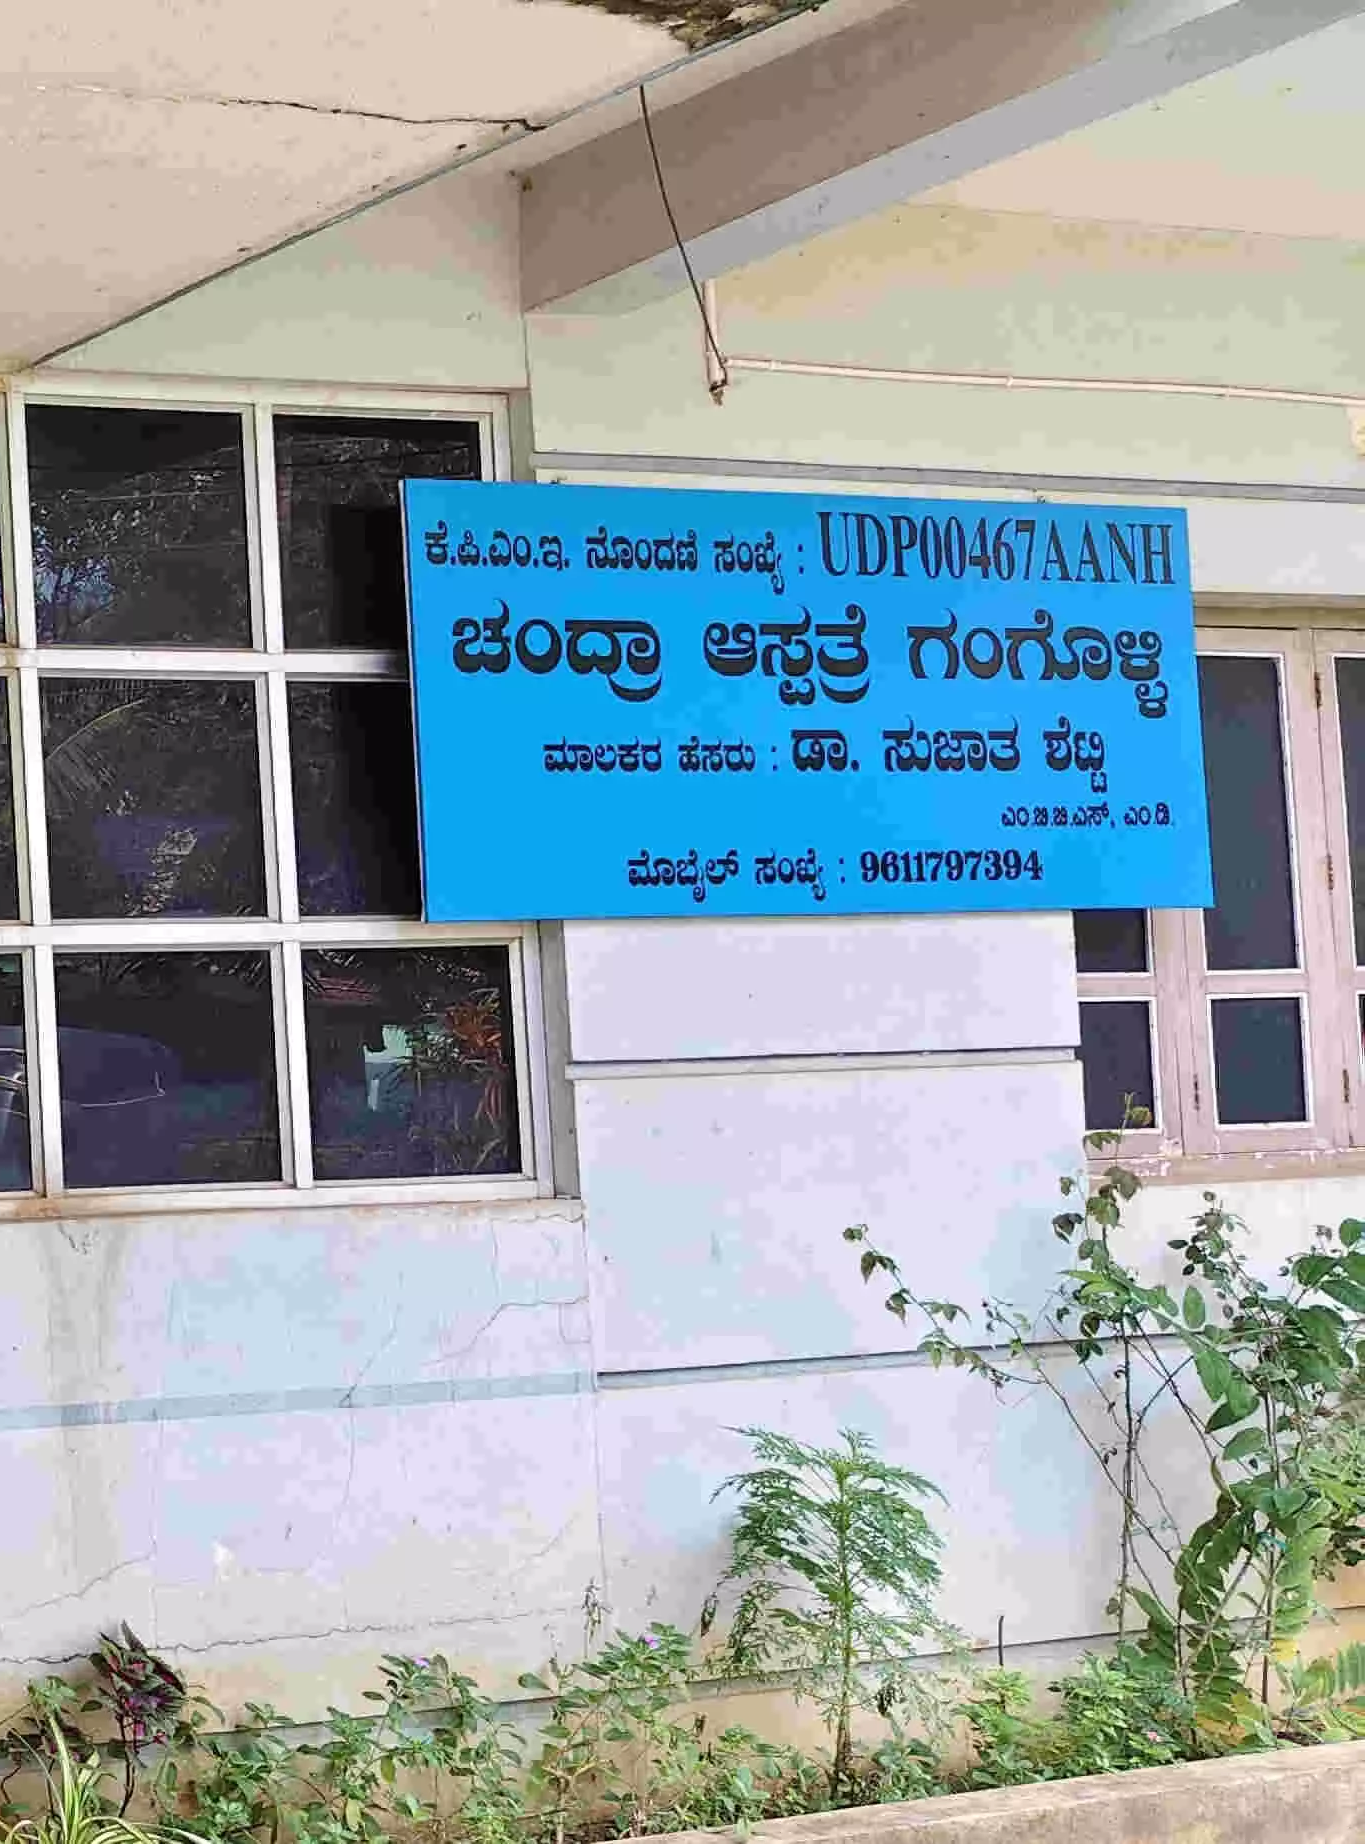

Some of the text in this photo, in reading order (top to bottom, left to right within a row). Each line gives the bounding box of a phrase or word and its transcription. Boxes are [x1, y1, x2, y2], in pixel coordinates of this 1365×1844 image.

[714, 531, 784, 595] ಸಂಖ್ಯೆ
[816, 511, 1174, 584] UDP00467AANH
[452, 600, 1168, 719] ಚಂದ್ರಾ ಆಸ್ಪತ್ರೆ ಗಂಗೊಳ್ಳಿ
[543, 736, 661, 772] ಮಾಲಕರ
[679, 736, 755, 772] ಹೆಸರು
[791, 730, 859, 772] ಡಾ.
[883, 716, 1020, 772] ಸುಜಾತ
[1043, 716, 1107, 793] ಶೆಟ್ಟಿ
[628, 849, 738, 903] ಮೊಬೈಲ್
[755, 848, 826, 901] ಸಂಖ್ಯೆ
[861, 849, 1042, 882] 9611797394
